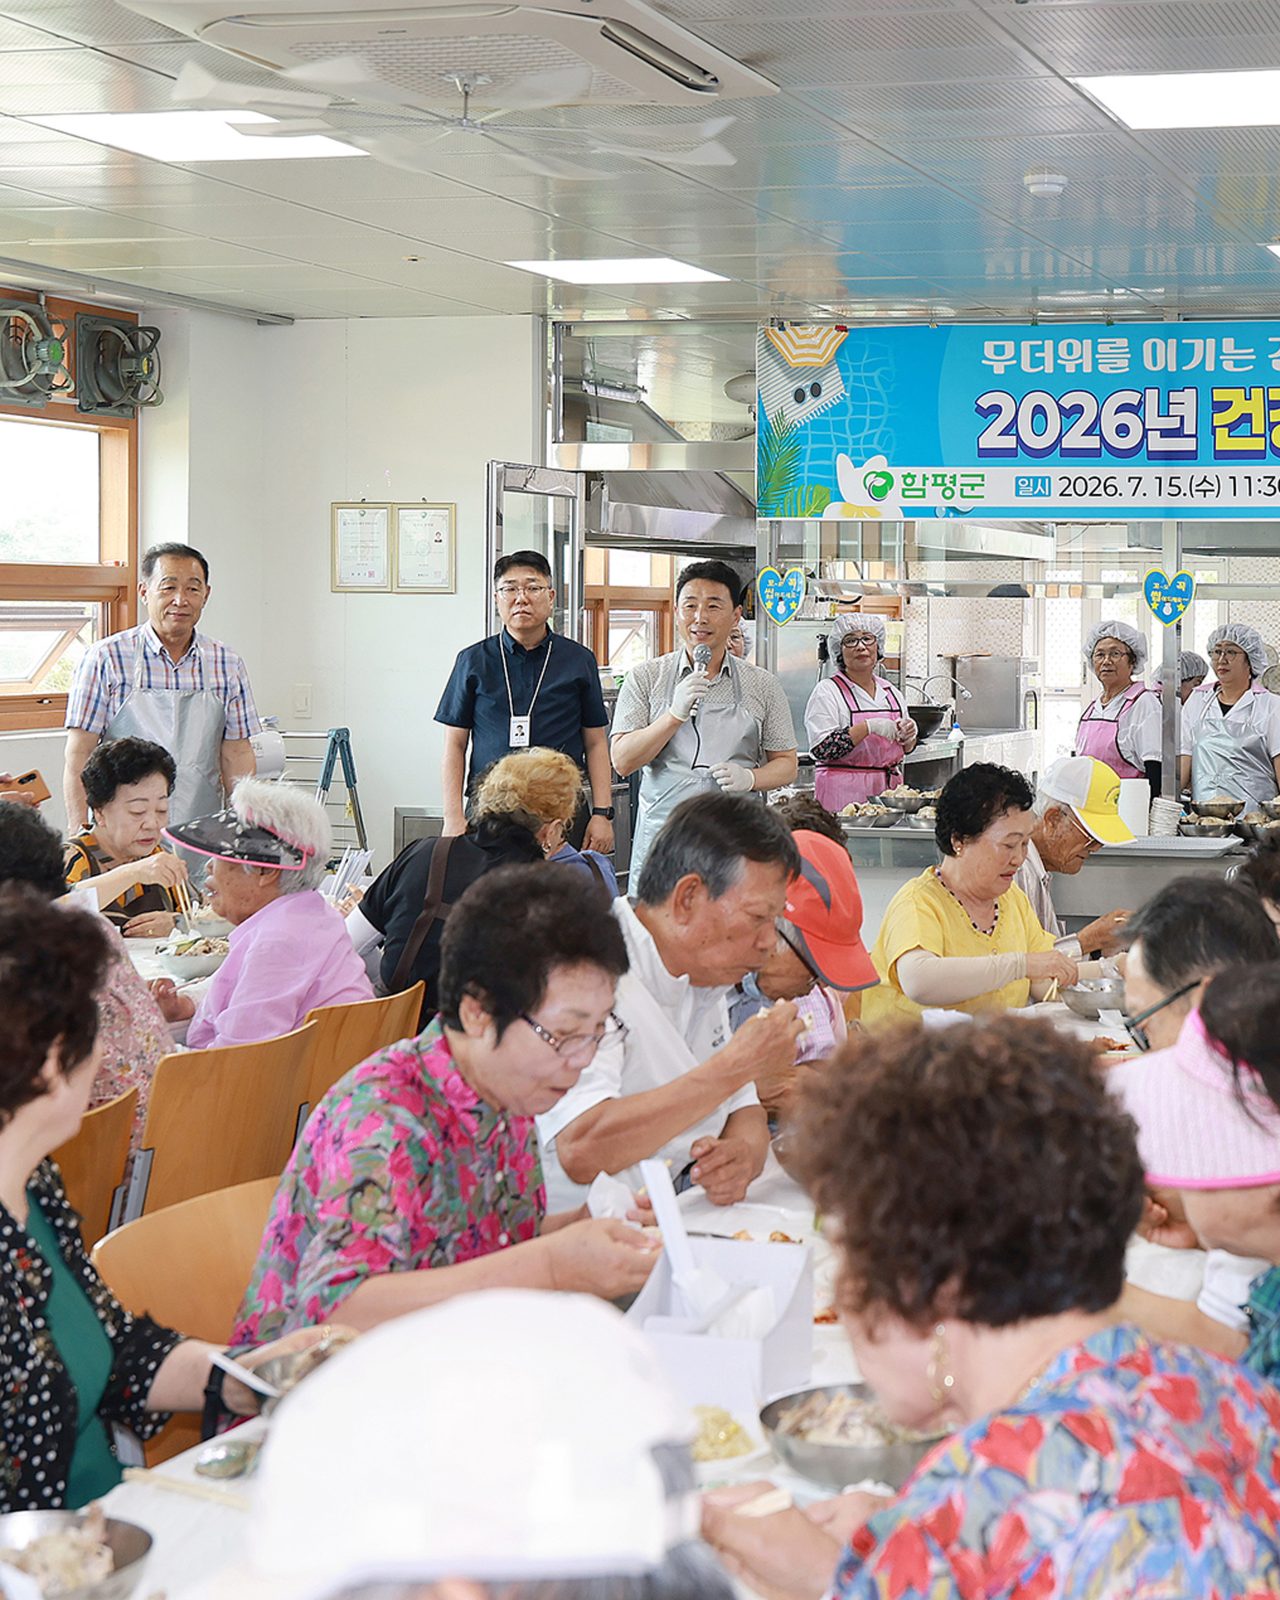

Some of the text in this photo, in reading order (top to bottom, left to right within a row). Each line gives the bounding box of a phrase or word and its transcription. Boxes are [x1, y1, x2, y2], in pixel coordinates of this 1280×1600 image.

[981, 338, 1131, 375] 무더위를
[1143, 337, 1257, 373] 이기는
[974, 386, 1200, 459] 2026년
[901, 472, 985, 500] 함평군
[1018, 478, 1049, 495] 일시
